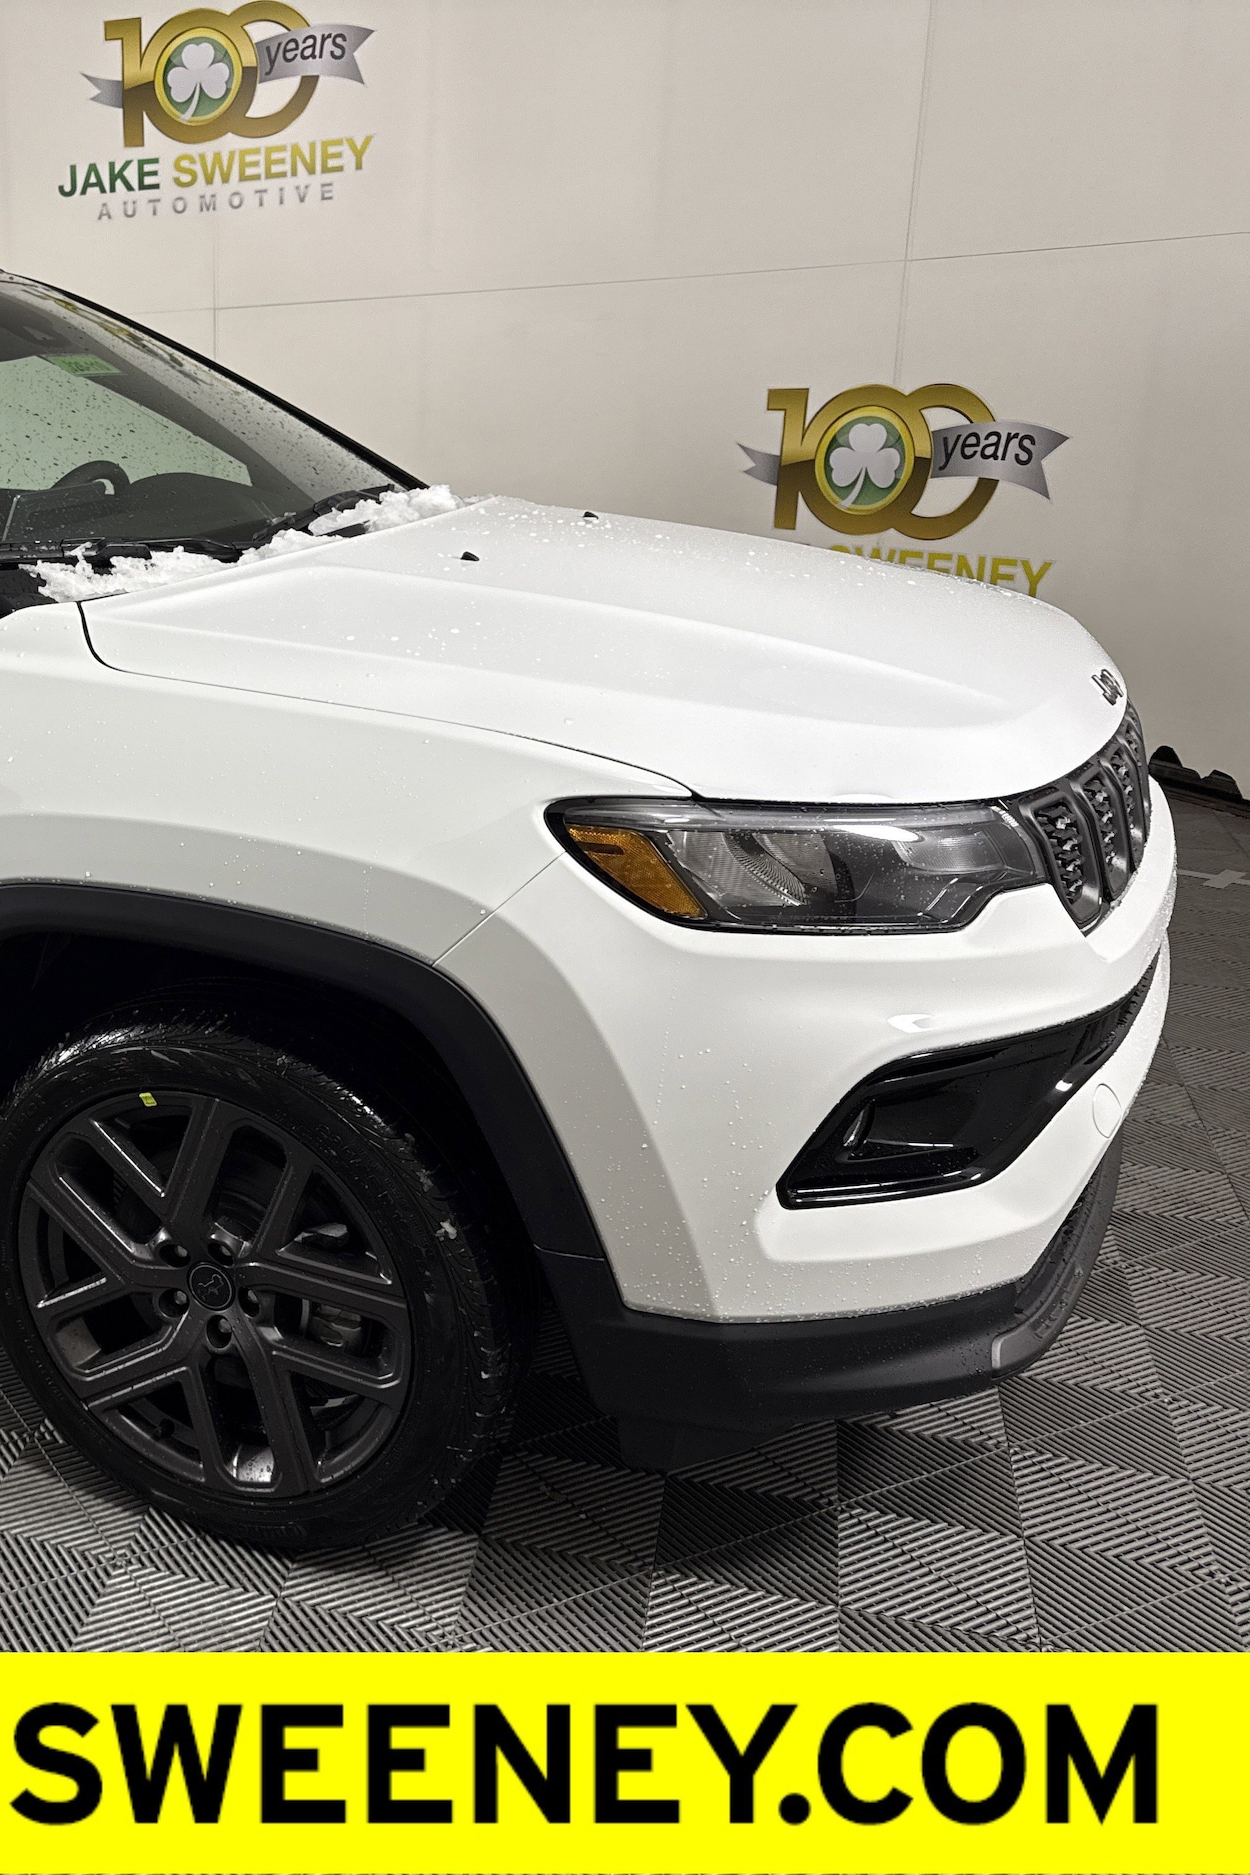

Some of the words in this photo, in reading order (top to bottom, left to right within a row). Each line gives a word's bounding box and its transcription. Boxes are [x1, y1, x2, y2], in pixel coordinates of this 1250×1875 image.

[103, 1, 320, 148] 100
[264, 30, 348, 75] years
[58, 157, 160, 198] JAKE
[173, 134, 373, 188] SWEENEY
[97, 182, 335, 221] AUTOMOTIVE
[767, 383, 1000, 541] 100
[939, 430, 1036, 471] years
